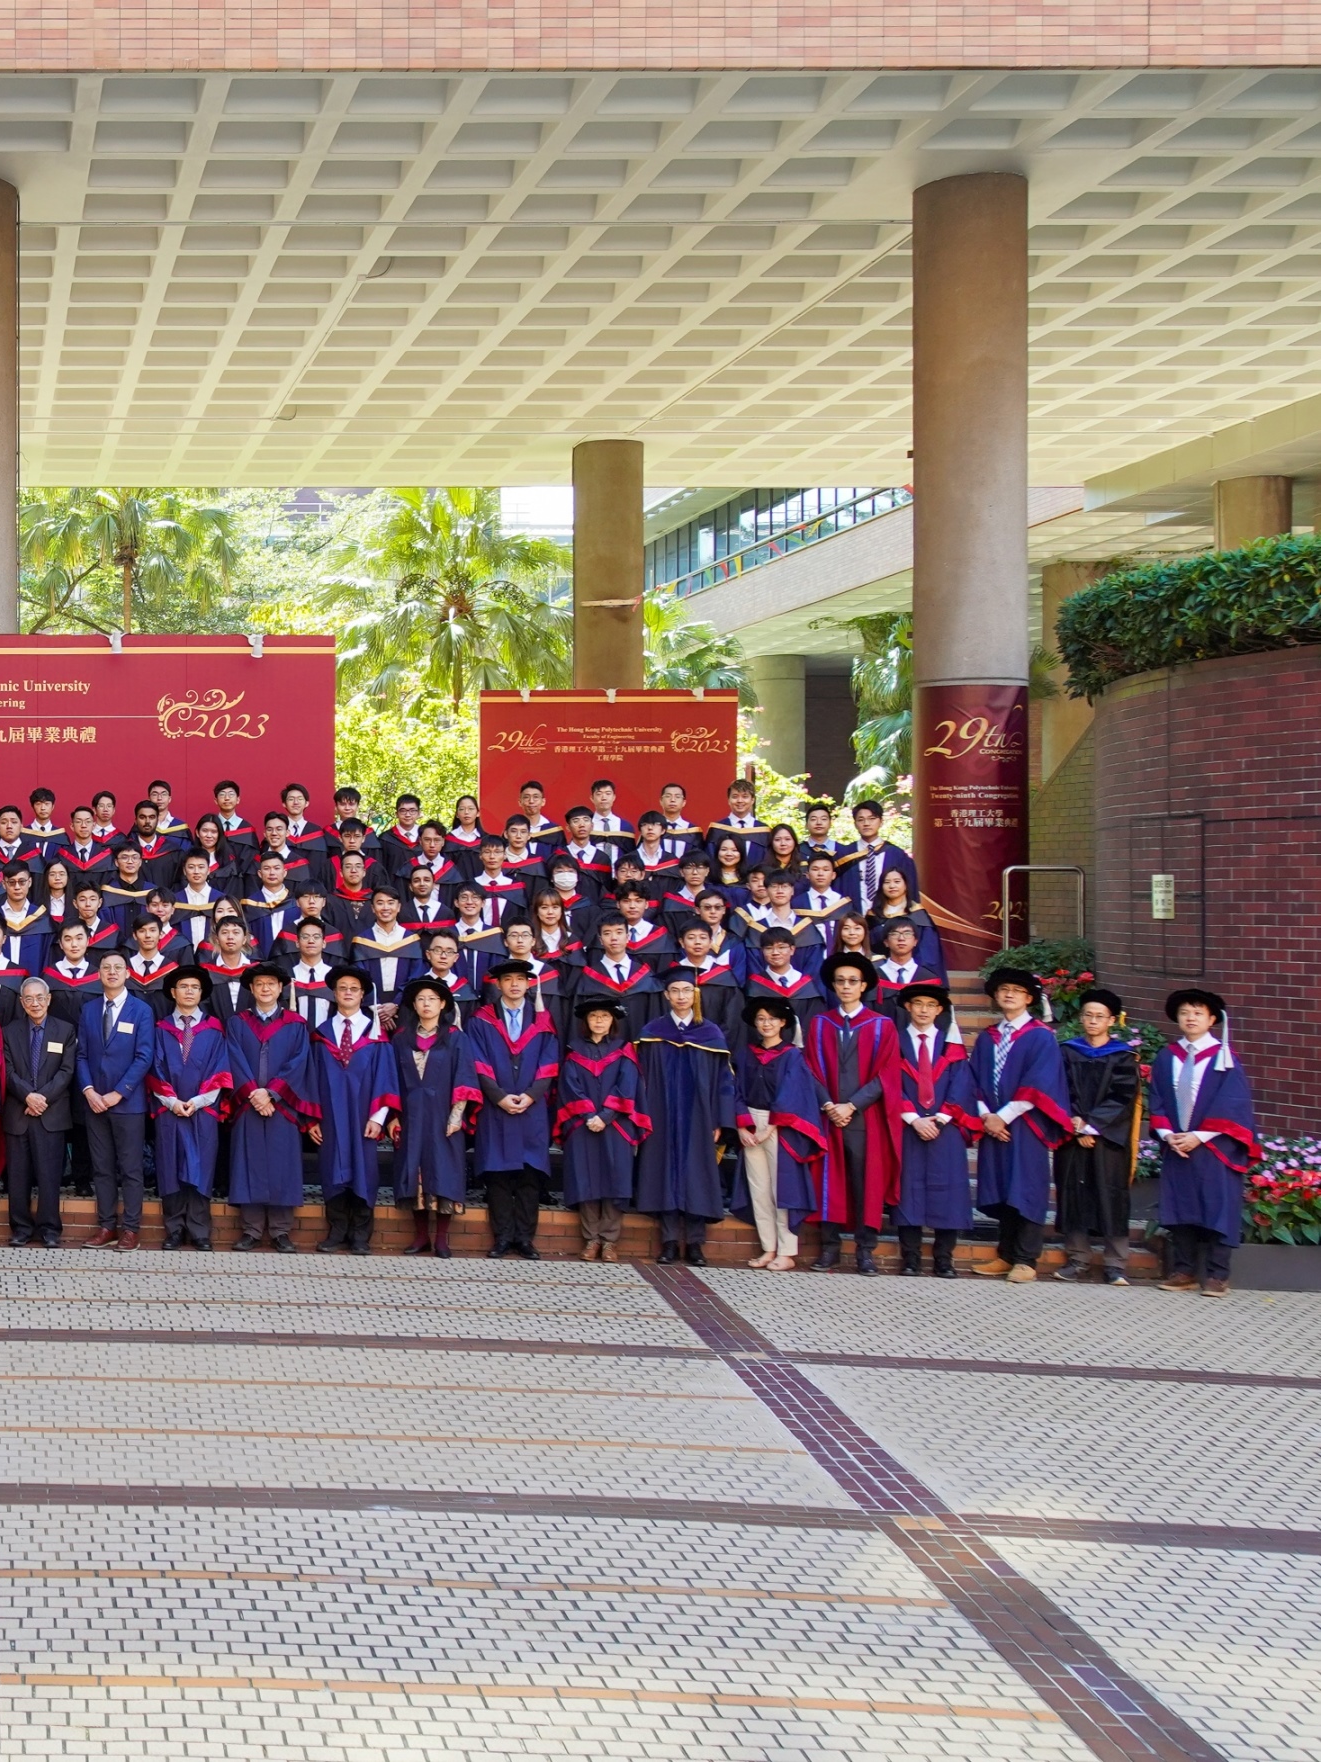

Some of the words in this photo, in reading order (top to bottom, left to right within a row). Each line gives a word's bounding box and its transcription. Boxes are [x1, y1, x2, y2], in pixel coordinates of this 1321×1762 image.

[23, 679, 91, 694] University
[184, 713, 270, 739] 2023
[487, 723, 548, 752] 29th
[684, 739, 730, 753] 2023
